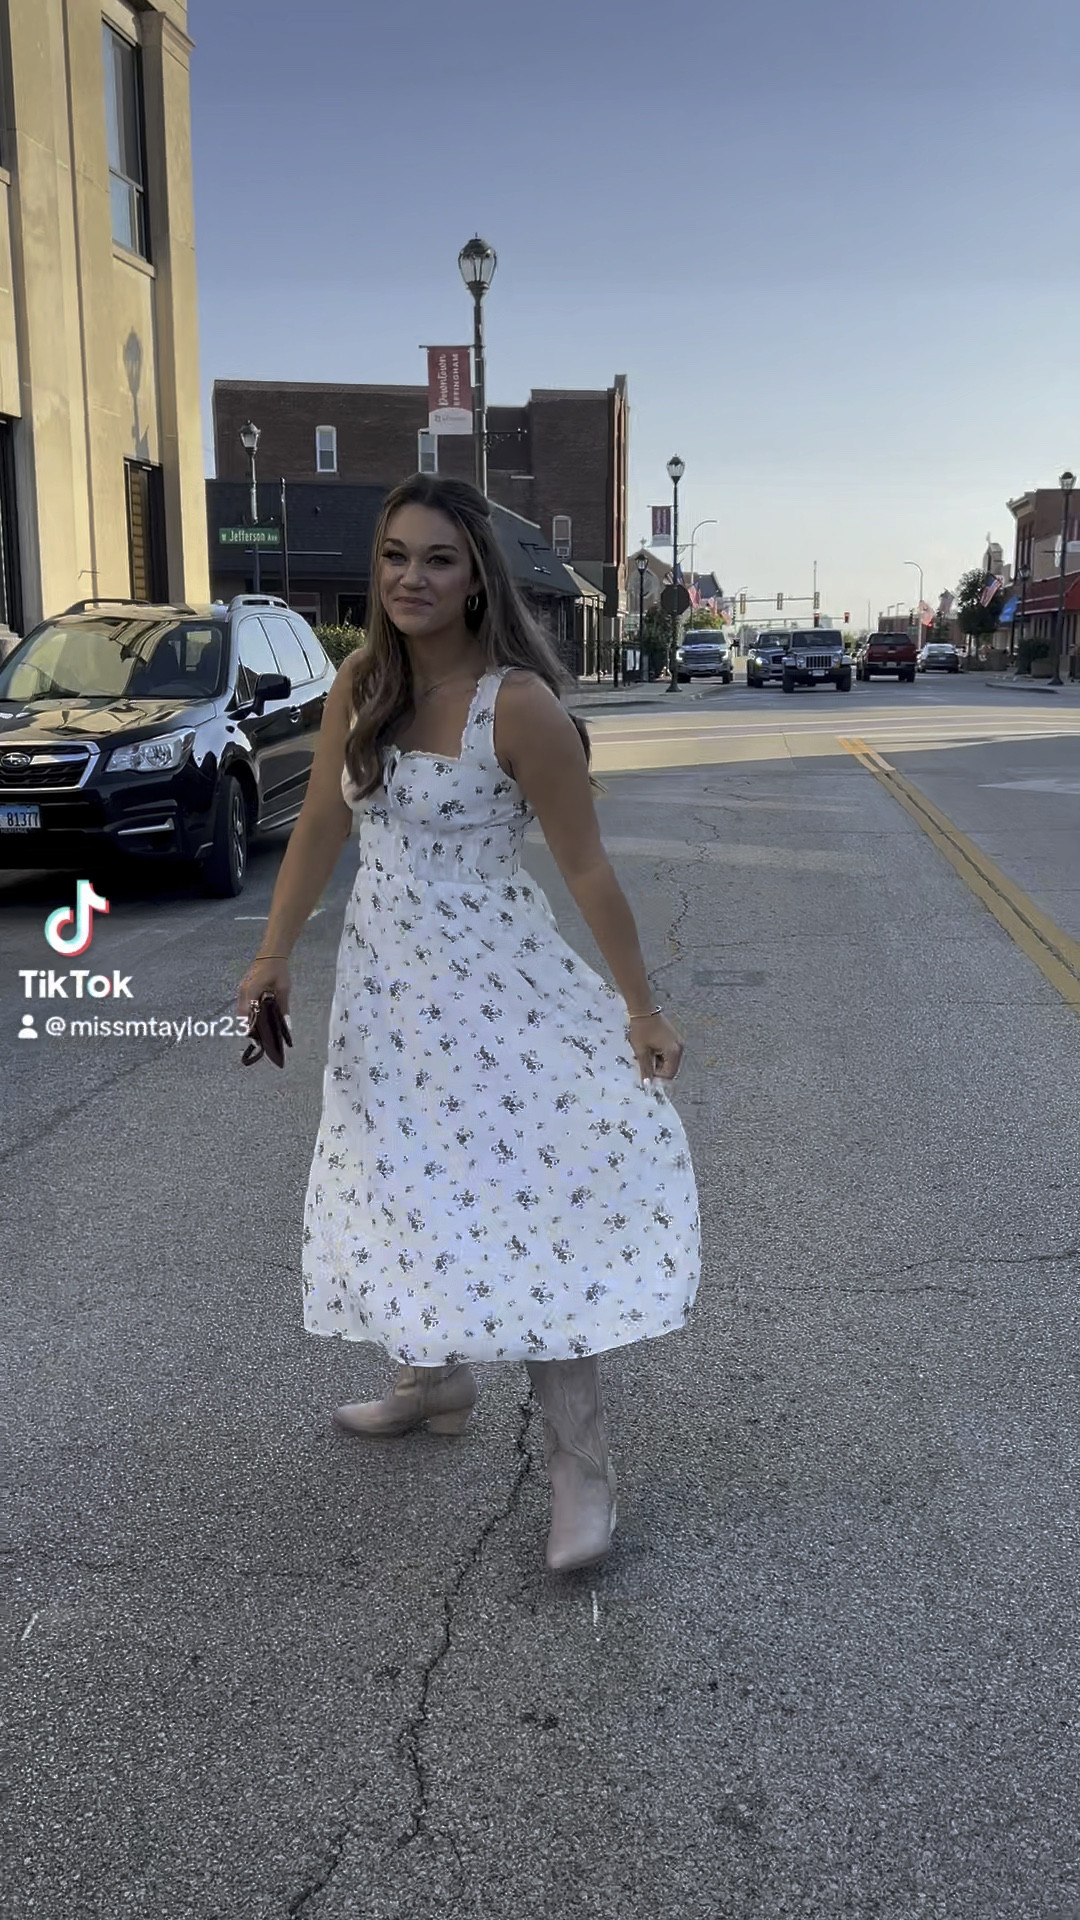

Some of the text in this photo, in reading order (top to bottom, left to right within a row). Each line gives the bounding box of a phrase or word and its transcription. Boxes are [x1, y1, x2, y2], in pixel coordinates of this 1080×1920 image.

[436, 353, 449, 406] Downtown
[452, 353, 460, 406] EFFINGHAM
[229, 530, 266, 542] Jefferson
